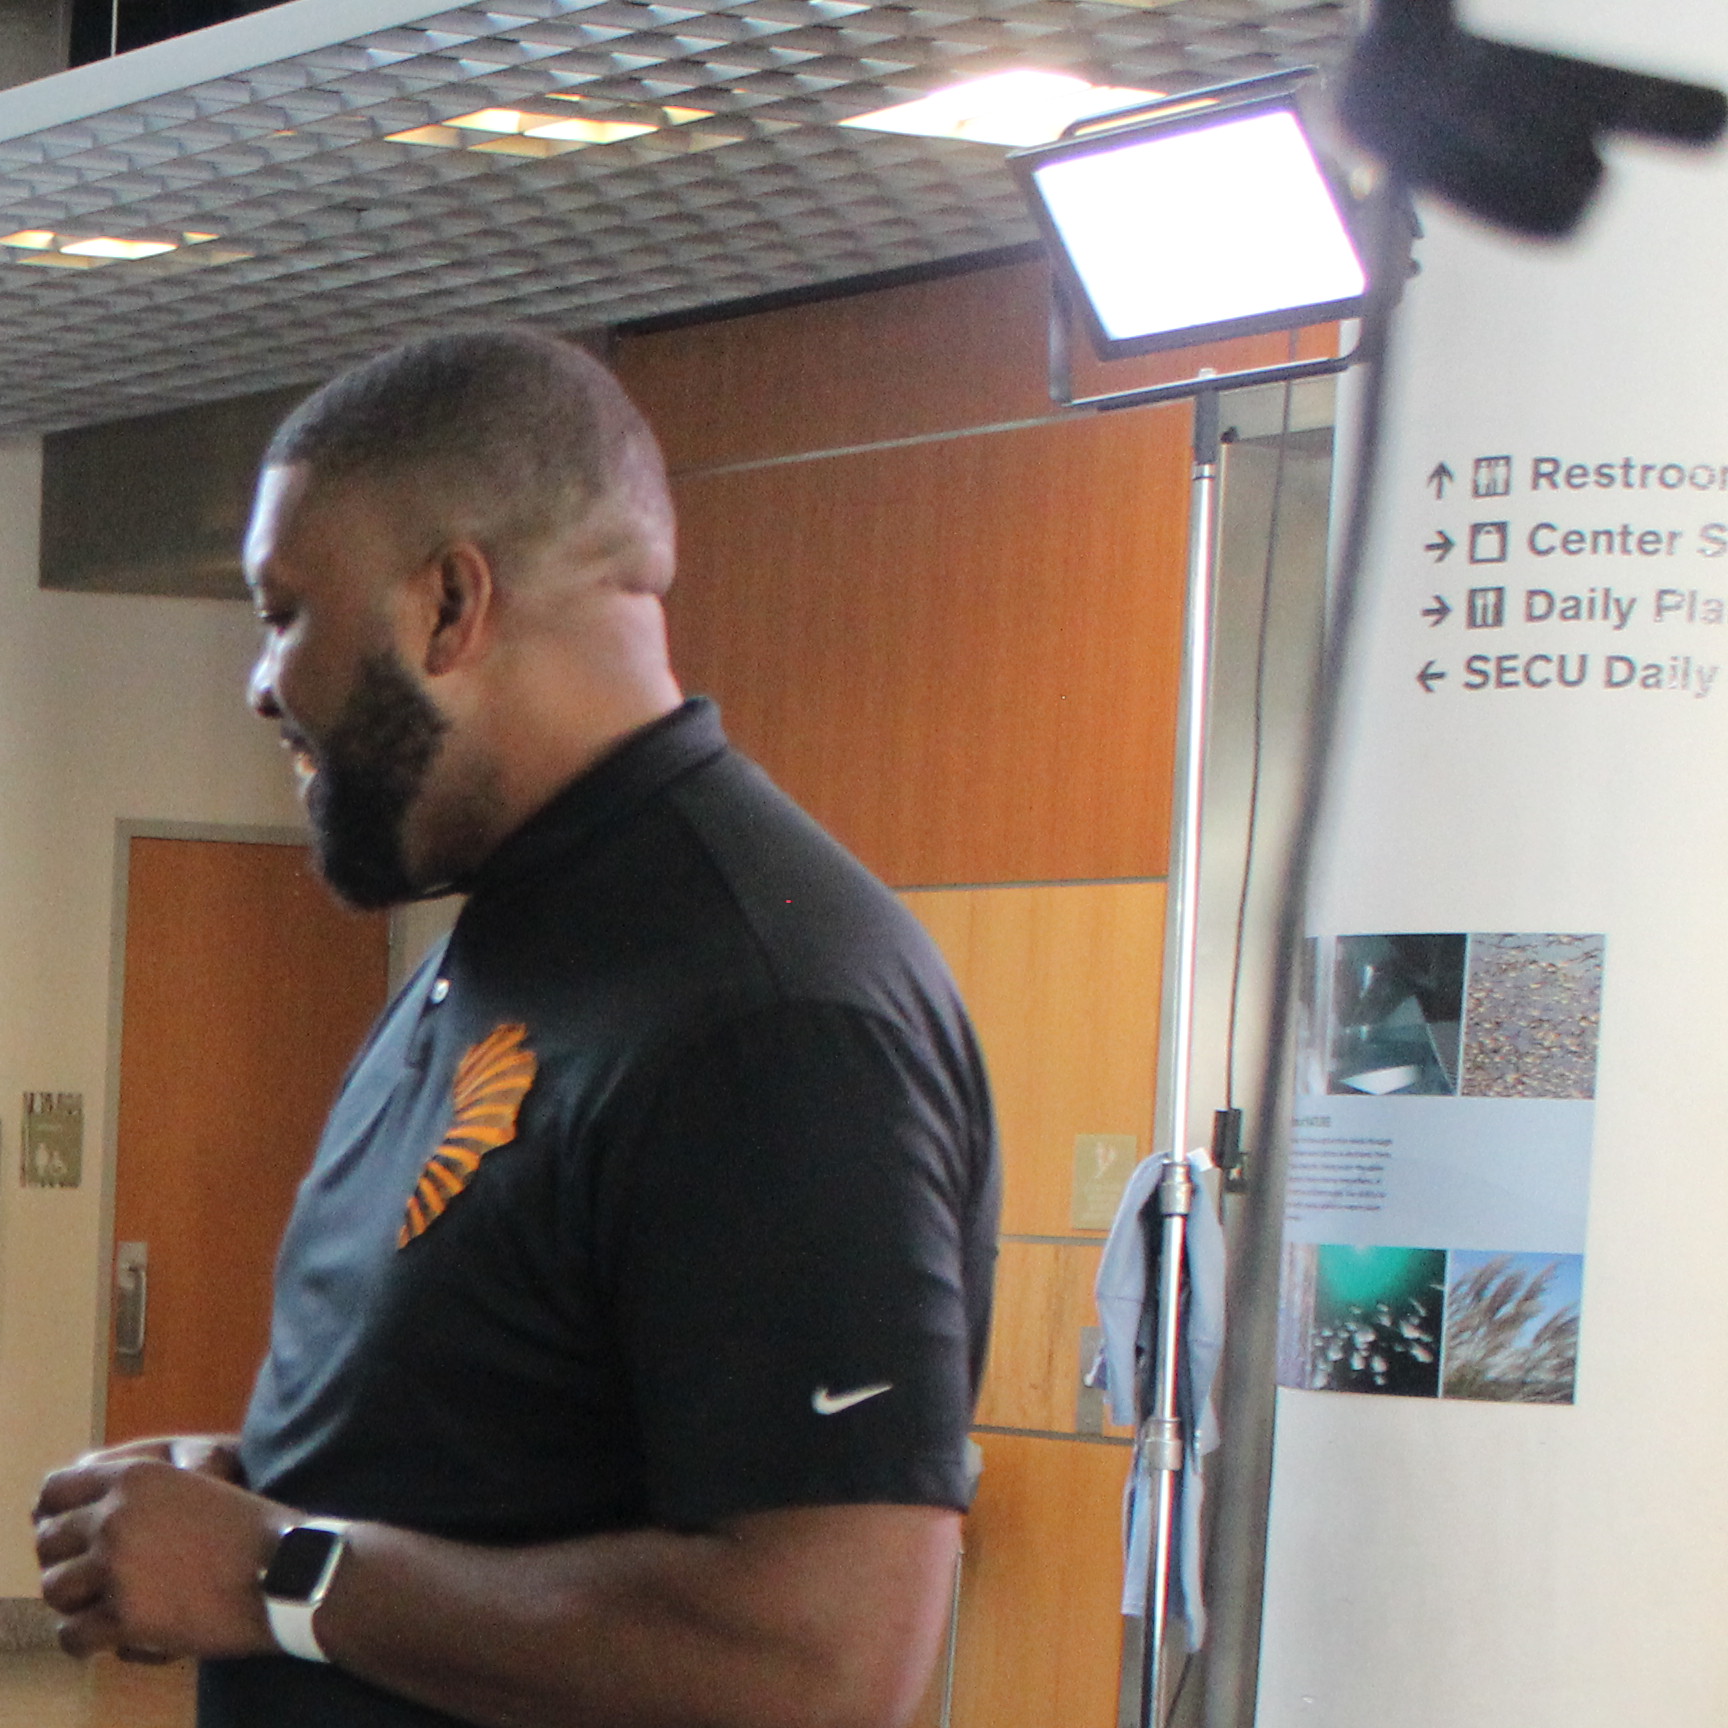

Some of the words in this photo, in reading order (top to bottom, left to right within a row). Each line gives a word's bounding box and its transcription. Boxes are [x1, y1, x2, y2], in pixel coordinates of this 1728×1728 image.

[1527, 521, 1684, 557] Center
[1524, 586, 1638, 631] Daily
[1462, 652, 1589, 691] SECU
[1603, 654, 1720, 700] Daily
